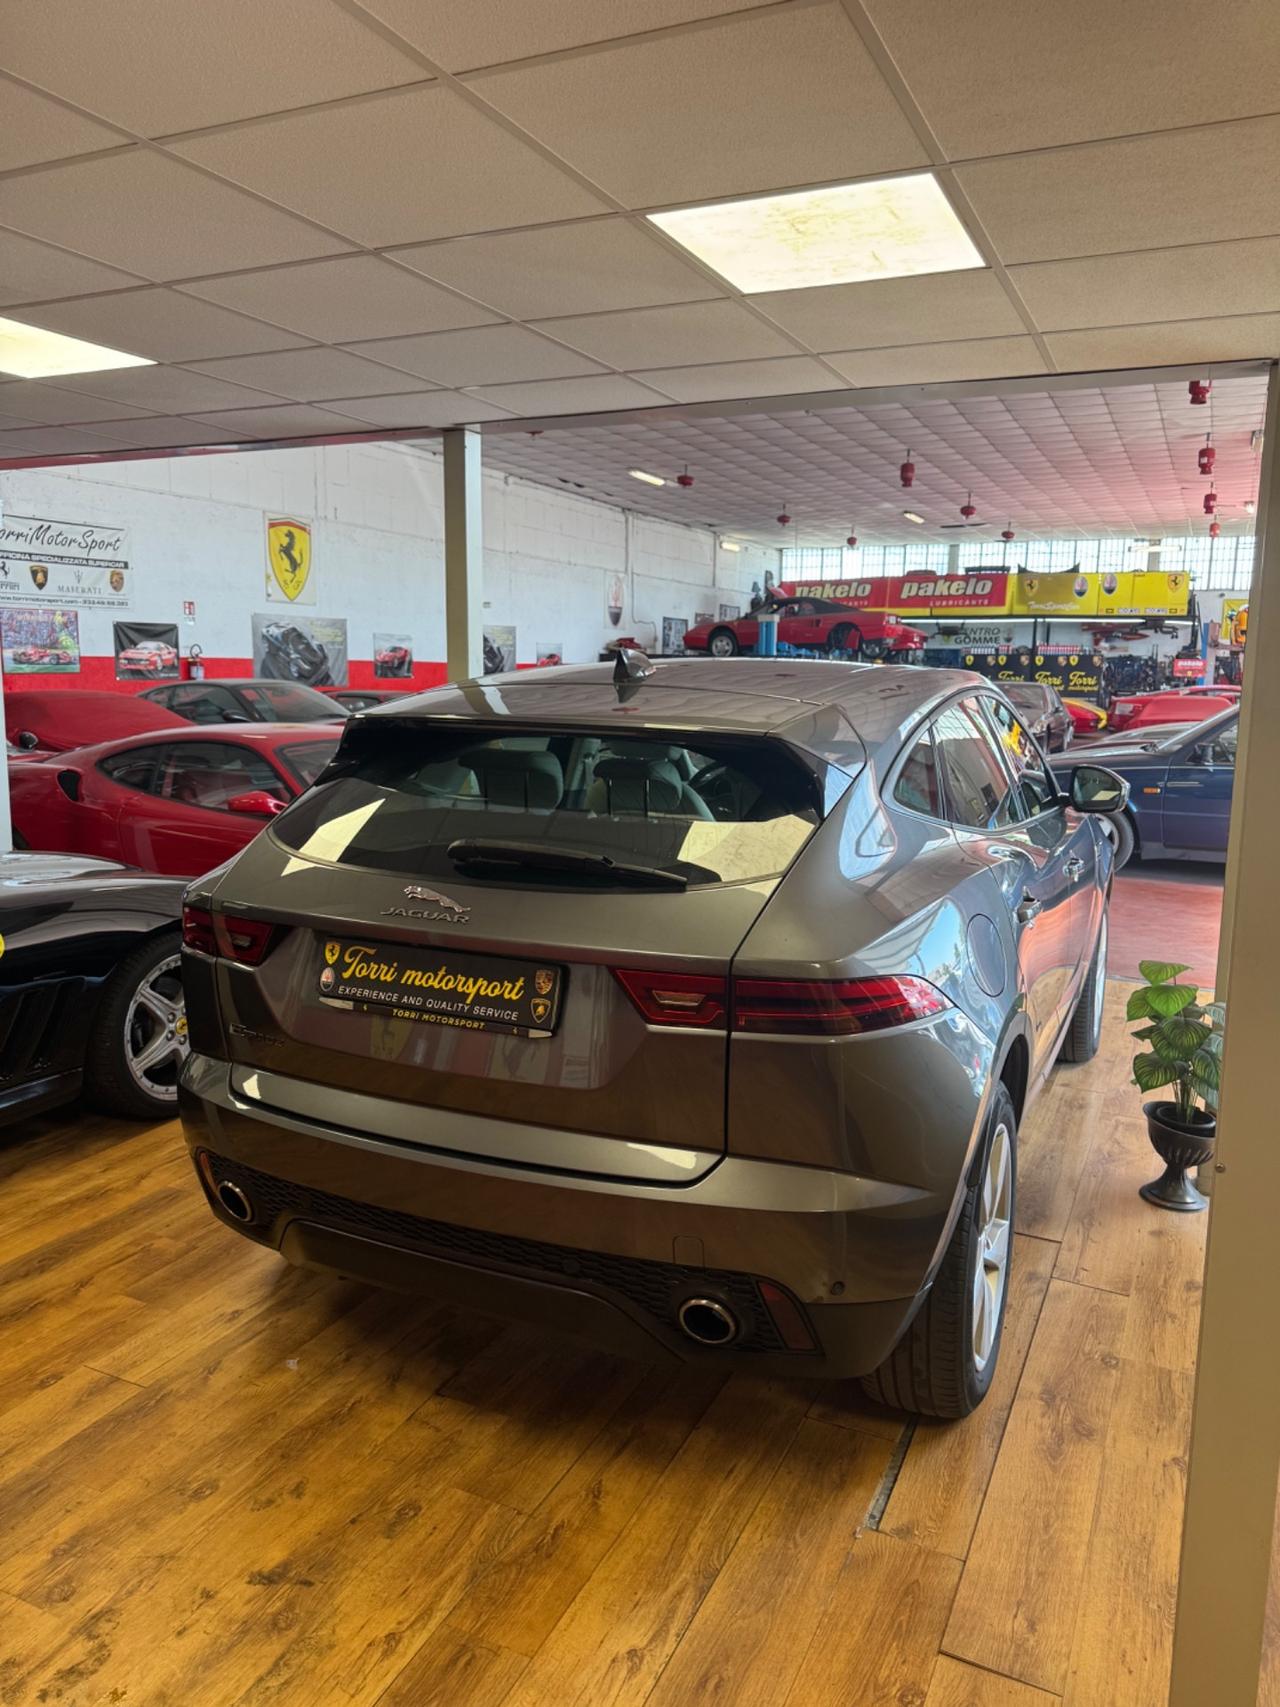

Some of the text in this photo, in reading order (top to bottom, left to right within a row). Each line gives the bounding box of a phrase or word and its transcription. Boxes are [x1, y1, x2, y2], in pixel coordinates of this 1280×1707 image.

[0, 524, 120, 556] orriMotorSport
[901, 577, 993, 599] pakelo
[954, 635, 1001, 645] GOMME
[1069, 670, 1097, 686] Torri
[380, 906, 471, 924] JAGUAR
[342, 946, 524, 1004] Torri motorsport
[338, 985, 519, 1021] EXPERIENCE AND QUALITY SERVICE
[392, 1008, 485, 1030] TORRI MOTORSPORT
